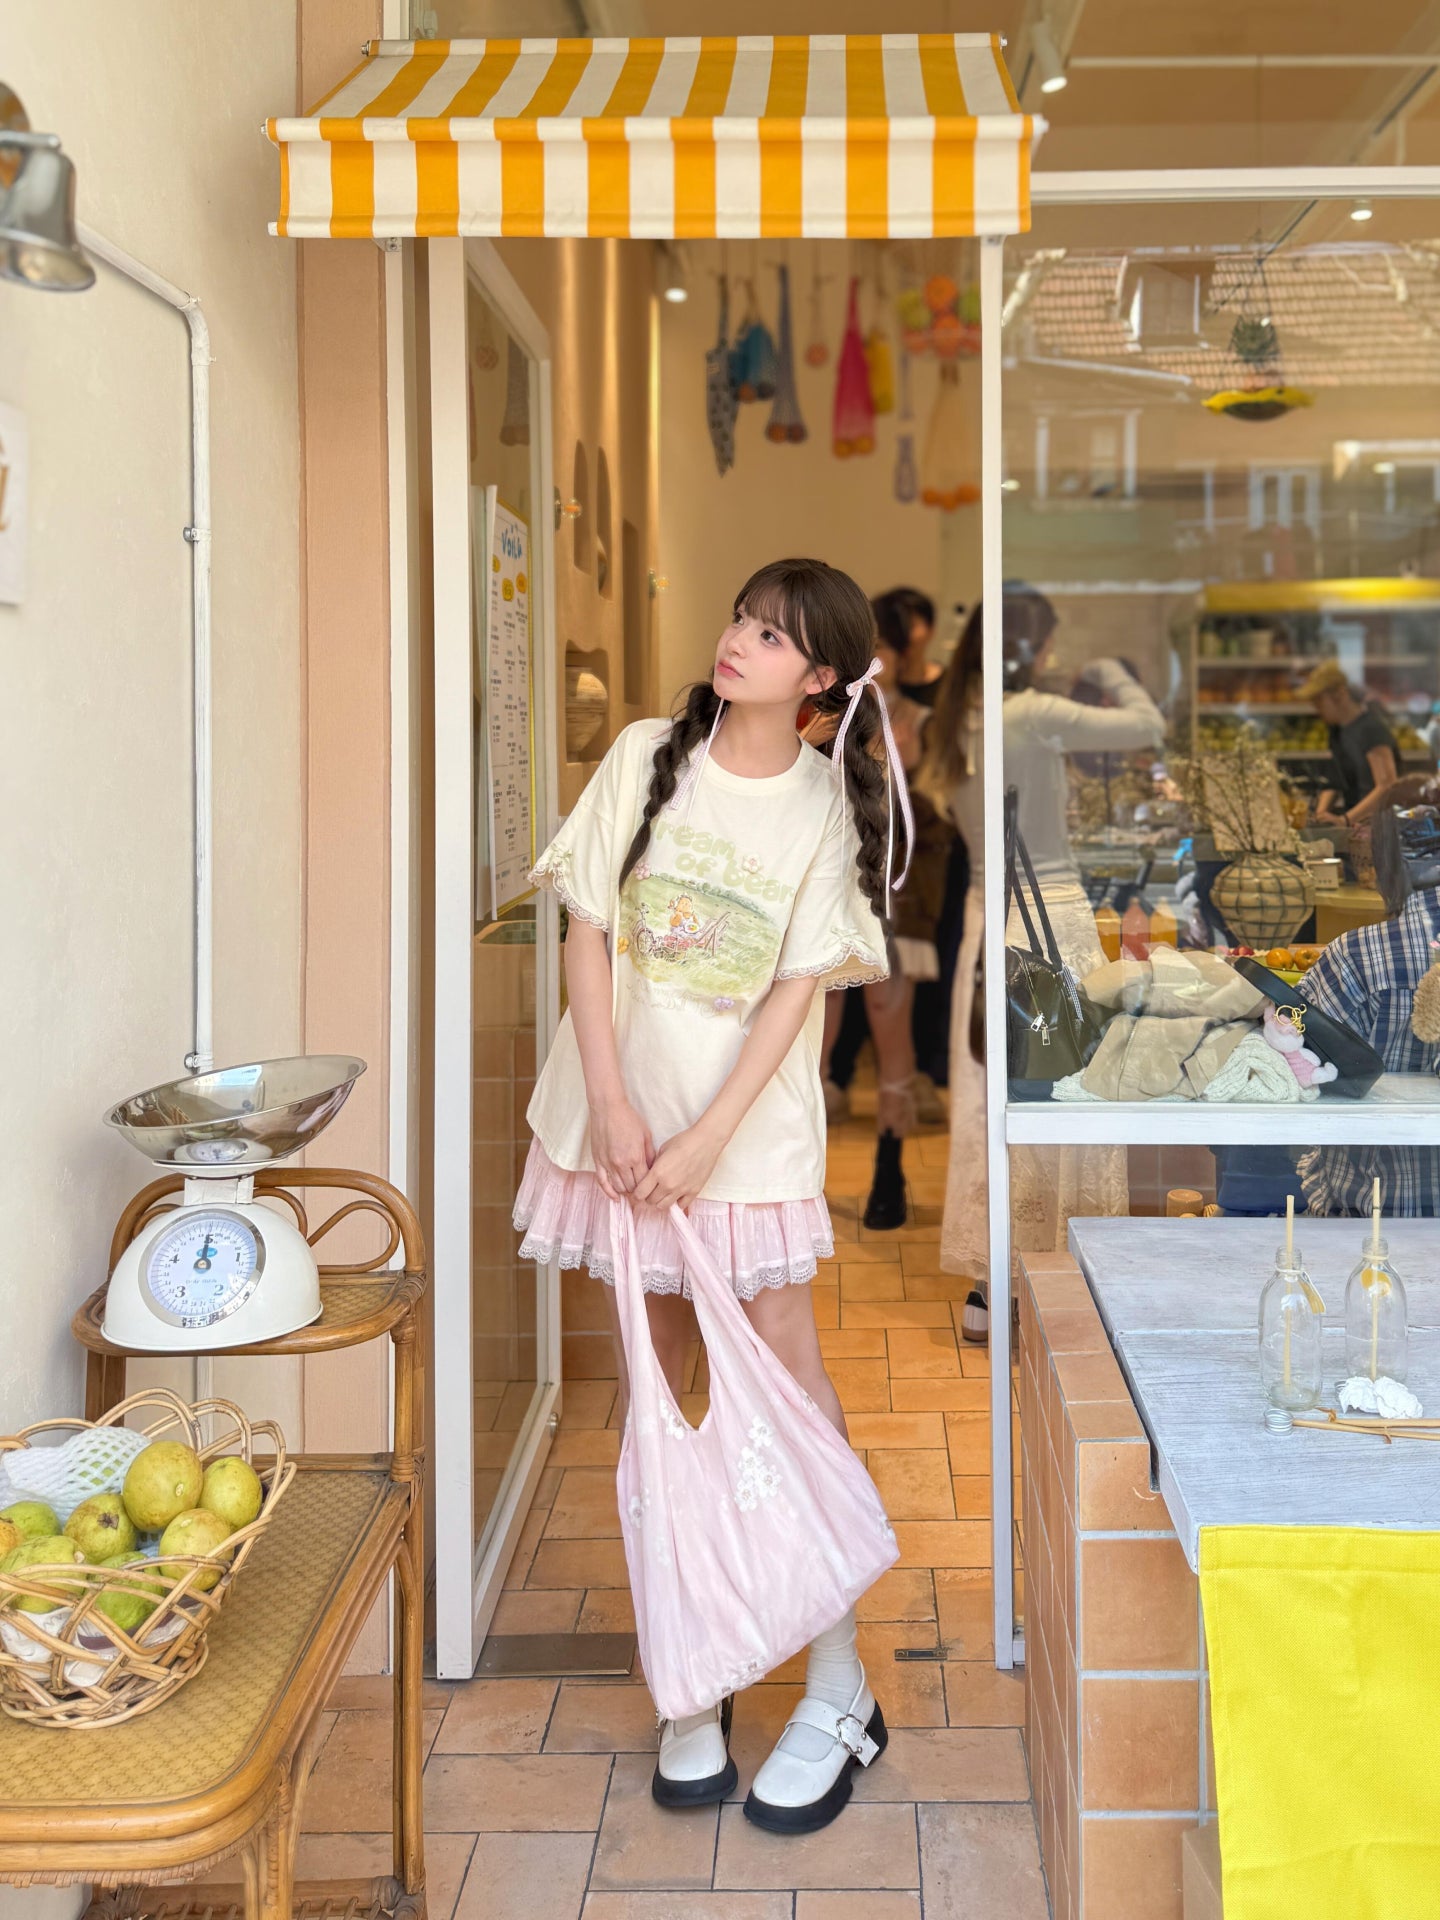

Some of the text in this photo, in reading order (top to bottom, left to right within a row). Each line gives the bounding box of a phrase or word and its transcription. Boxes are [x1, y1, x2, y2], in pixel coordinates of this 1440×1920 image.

[675, 852, 795, 905] of bear
[169, 1253, 180, 1264] 4
[235, 1252, 241, 1262] 1
[175, 1285, 186, 1298] 3
[214, 1284, 224, 1296] 2
